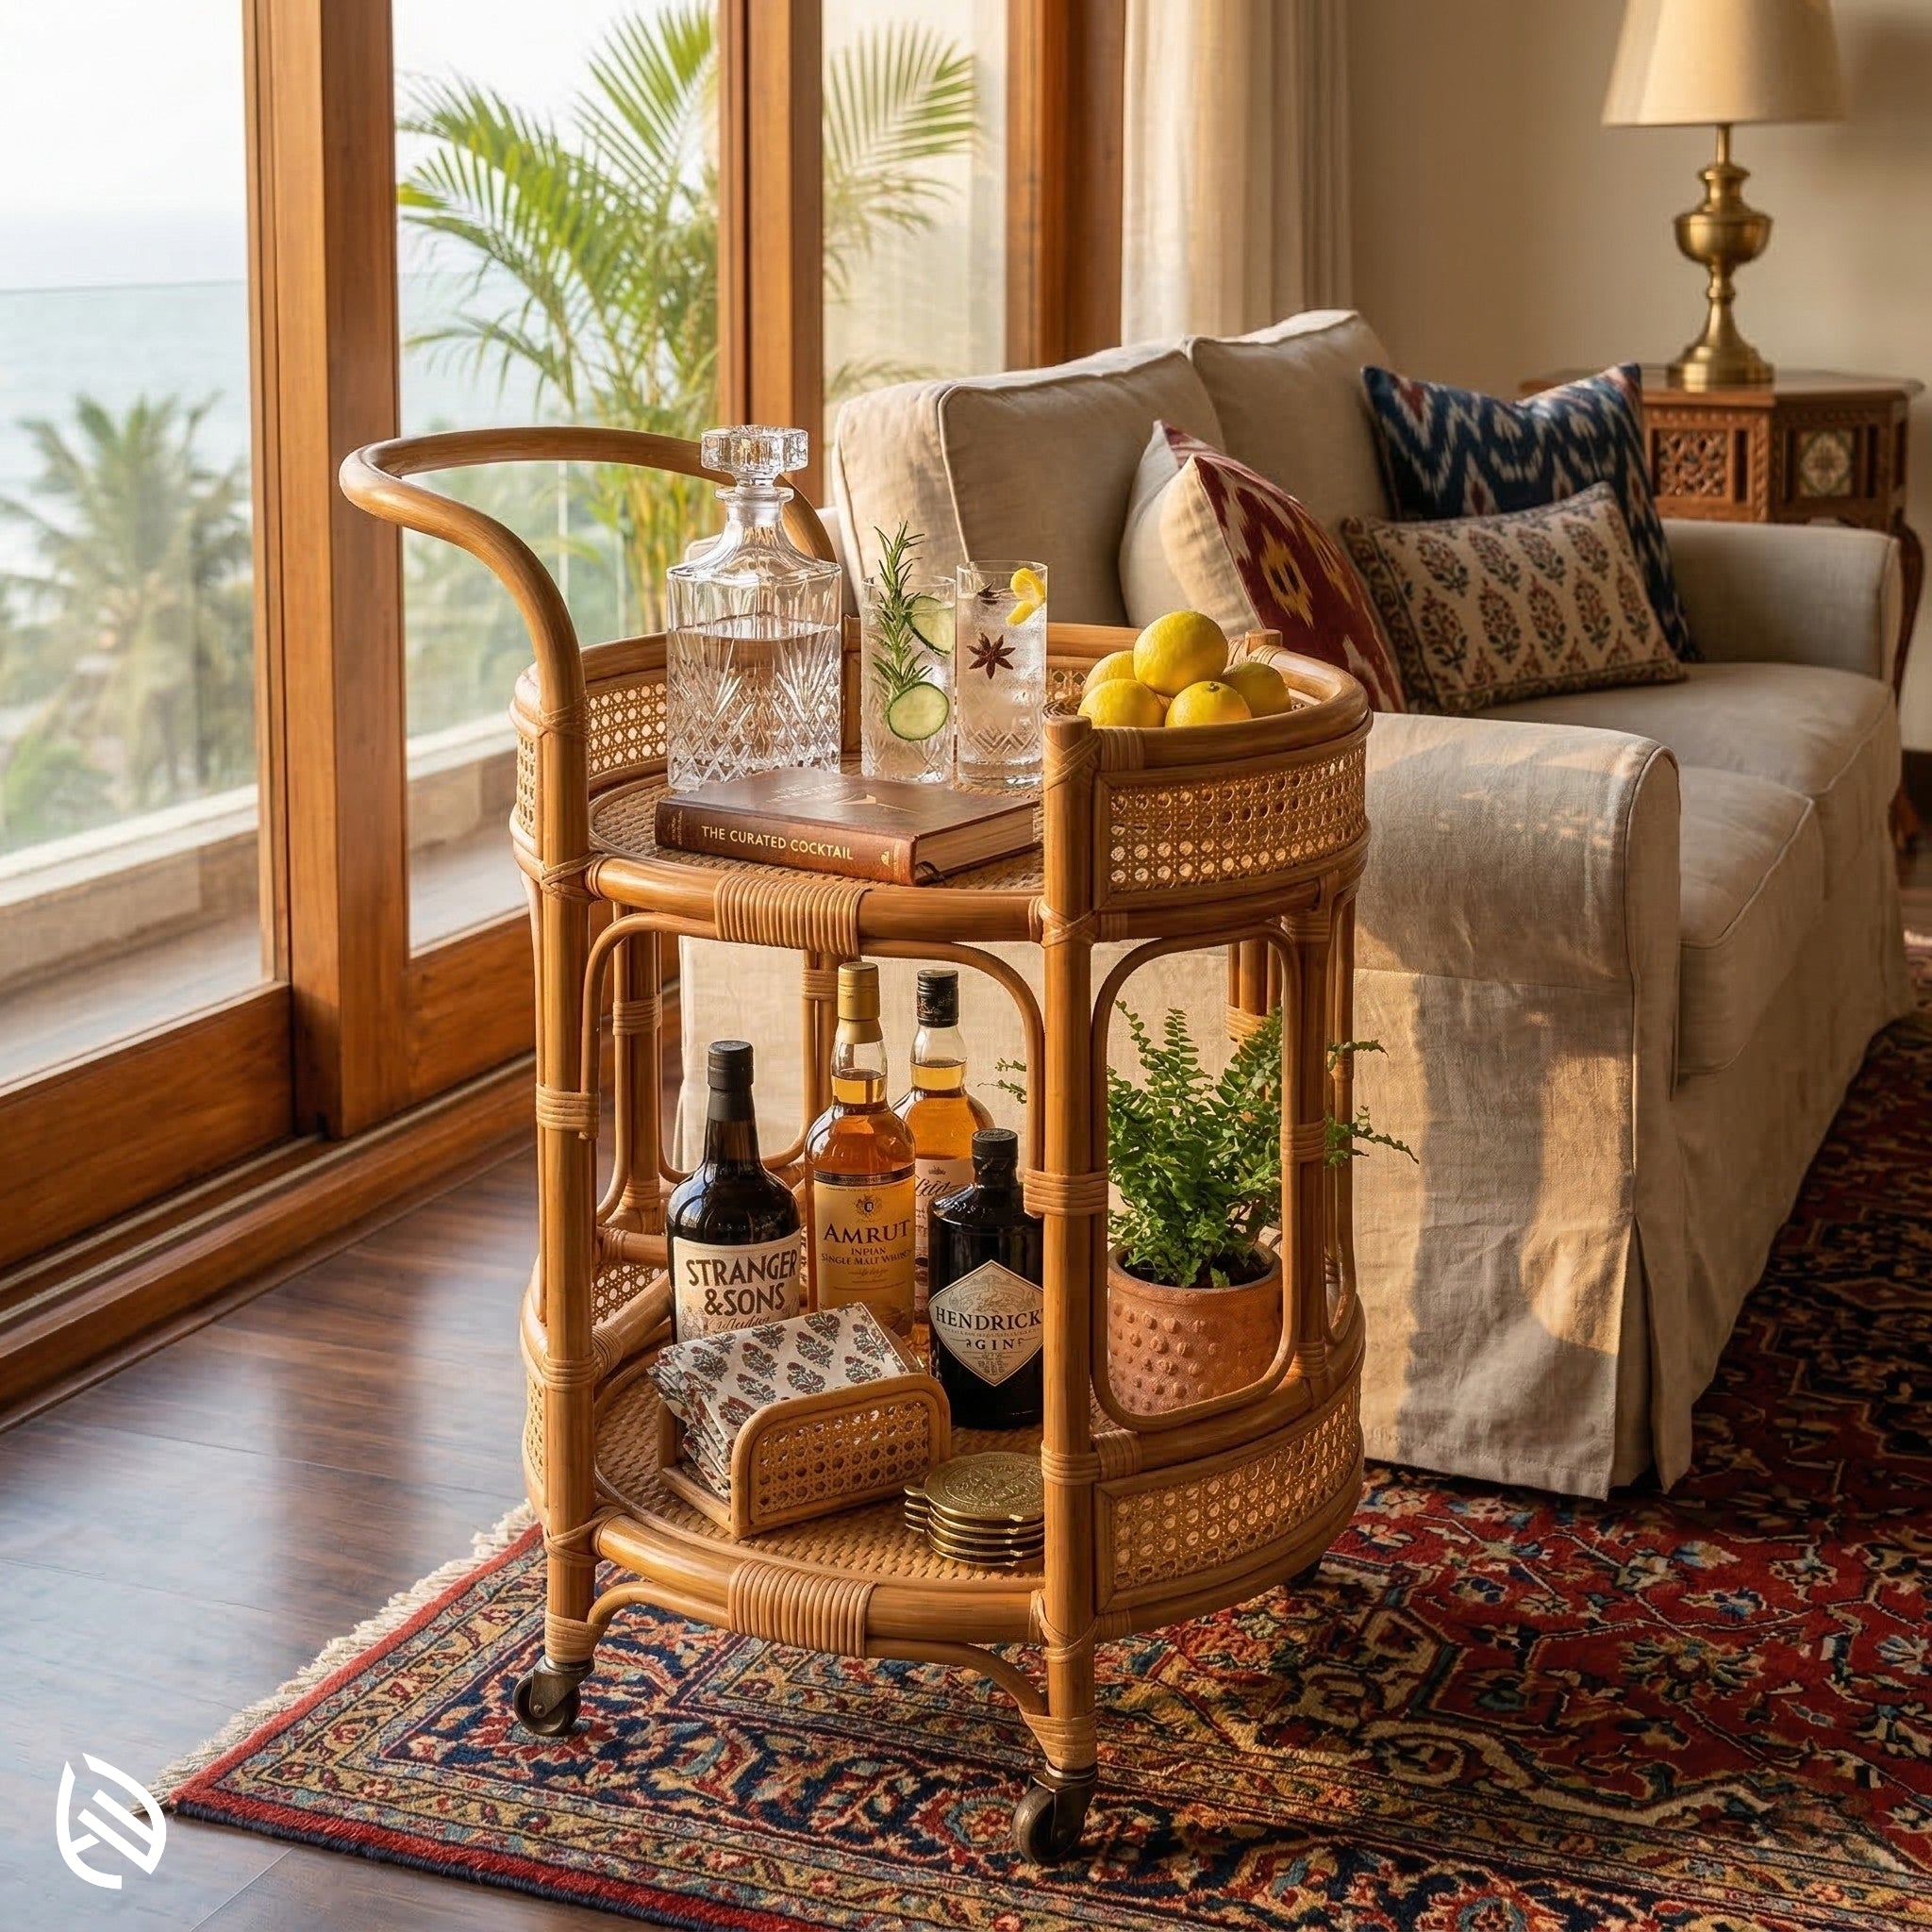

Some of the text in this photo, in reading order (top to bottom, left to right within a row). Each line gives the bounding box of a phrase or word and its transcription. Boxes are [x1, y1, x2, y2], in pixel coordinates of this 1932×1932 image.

[701, 825, 725, 841] THE
[729, 830, 787, 849] CURATED
[790, 839, 854, 860] COCKTAIL
[824, 1219, 911, 1244] AMRUT
[686, 1249, 798, 1287] STRANGER
[704, 1282, 785, 1317] &SONS
[974, 1338, 1015, 1351] GIN
